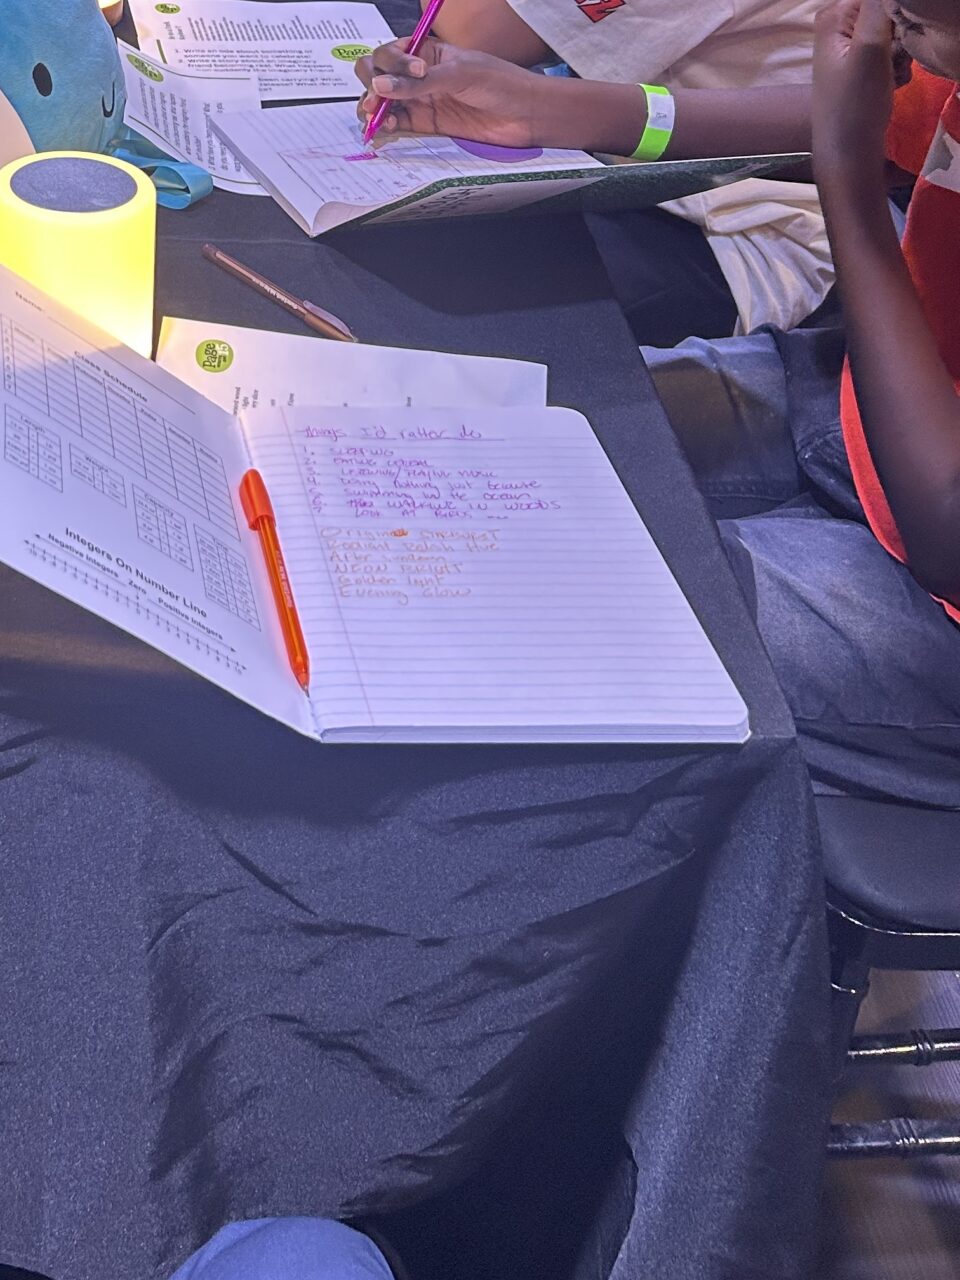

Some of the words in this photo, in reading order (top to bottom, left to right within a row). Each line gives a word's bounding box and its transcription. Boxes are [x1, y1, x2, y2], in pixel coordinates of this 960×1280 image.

[202, 343, 218, 368] Page
[65, 527, 113, 561] Integers
[115, 557, 133, 573] On
[136, 567, 180, 601] Number
[183, 596, 207, 619] Line
